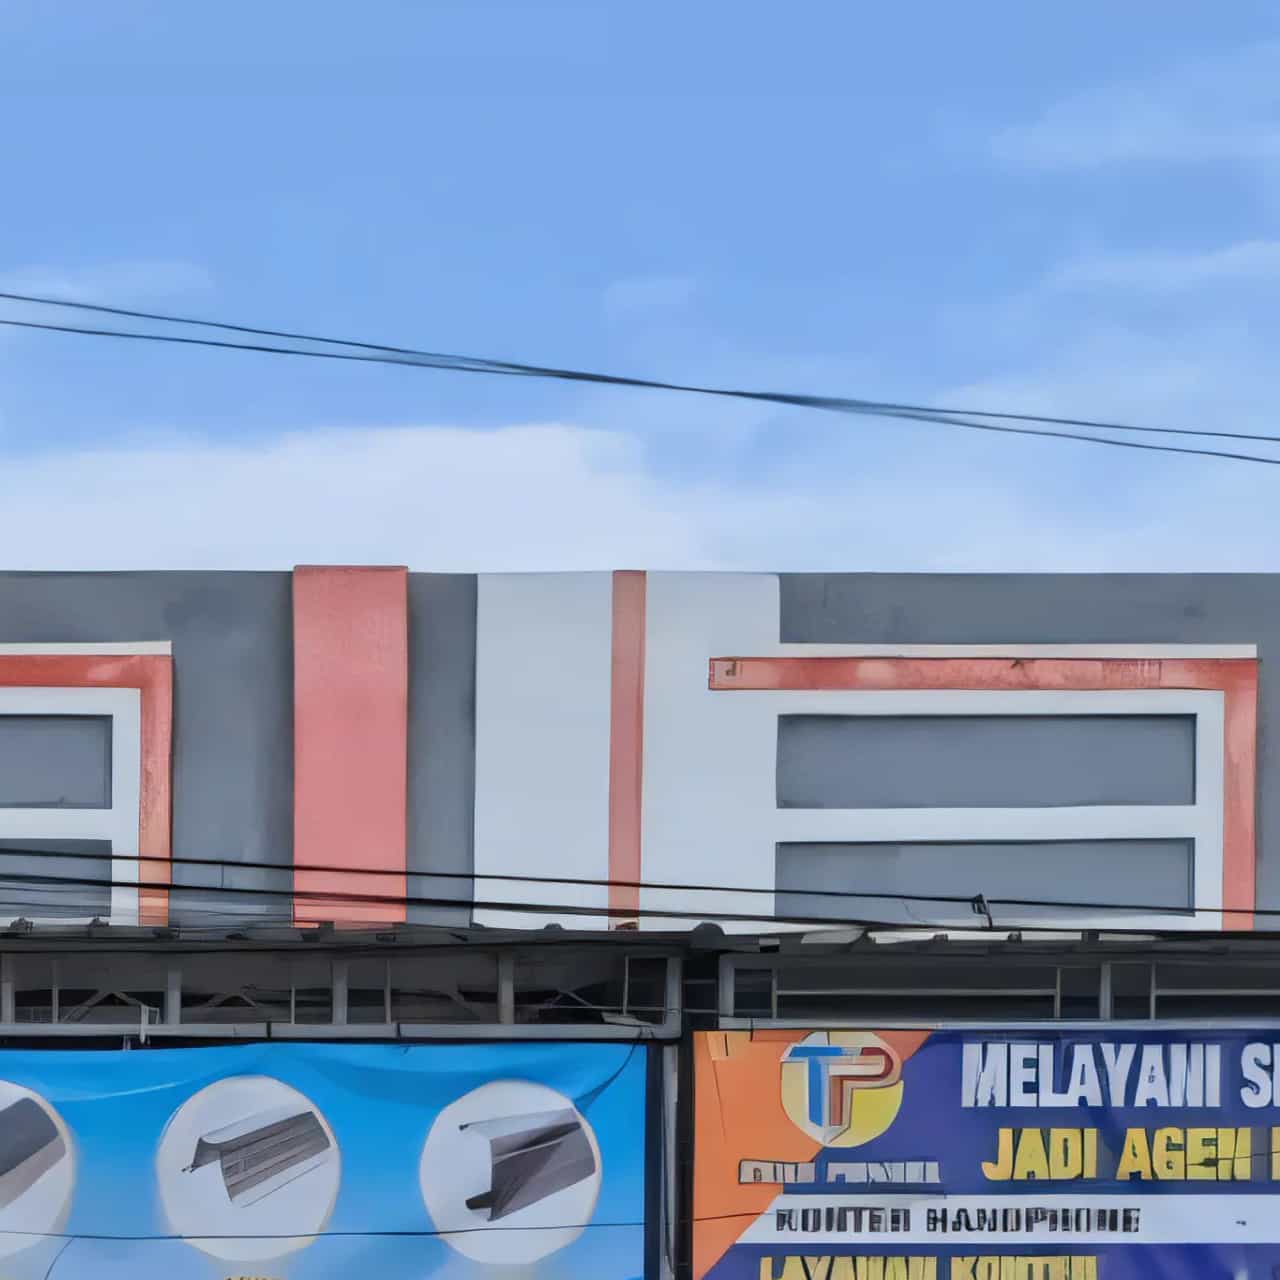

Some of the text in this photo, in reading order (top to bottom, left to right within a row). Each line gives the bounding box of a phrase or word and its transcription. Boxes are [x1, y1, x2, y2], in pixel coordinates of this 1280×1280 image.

[962, 1042, 1220, 1108] MELAYANI
[981, 1127, 1098, 1181] JADI
[1116, 1127, 1251, 1181] AGEN
